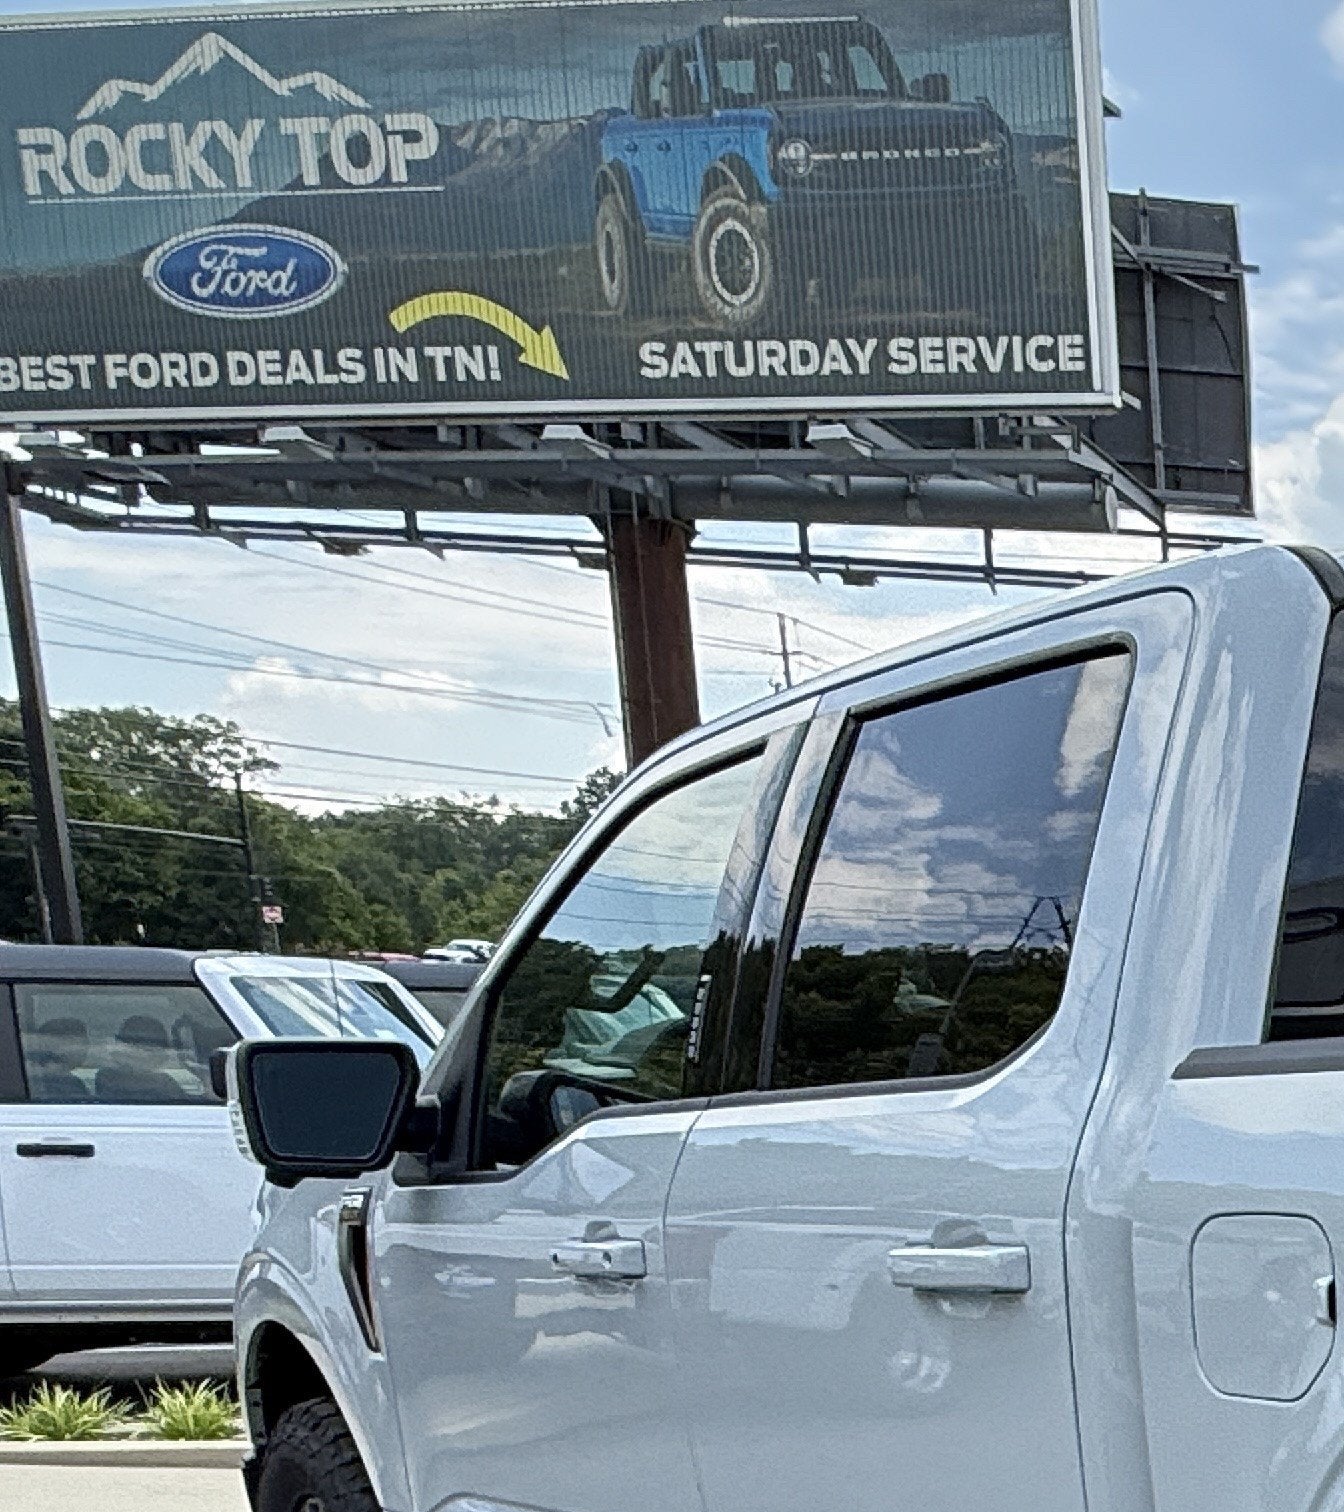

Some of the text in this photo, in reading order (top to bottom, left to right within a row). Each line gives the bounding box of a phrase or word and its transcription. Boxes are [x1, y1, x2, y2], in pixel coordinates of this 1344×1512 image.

[16, 112, 440, 196] ROCKY TOP
[190, 242, 299, 300] Ford
[0, 344, 502, 392] BEST FORD DEALS IN TN!
[639, 333, 1087, 379] SATURDAY SERVICE
